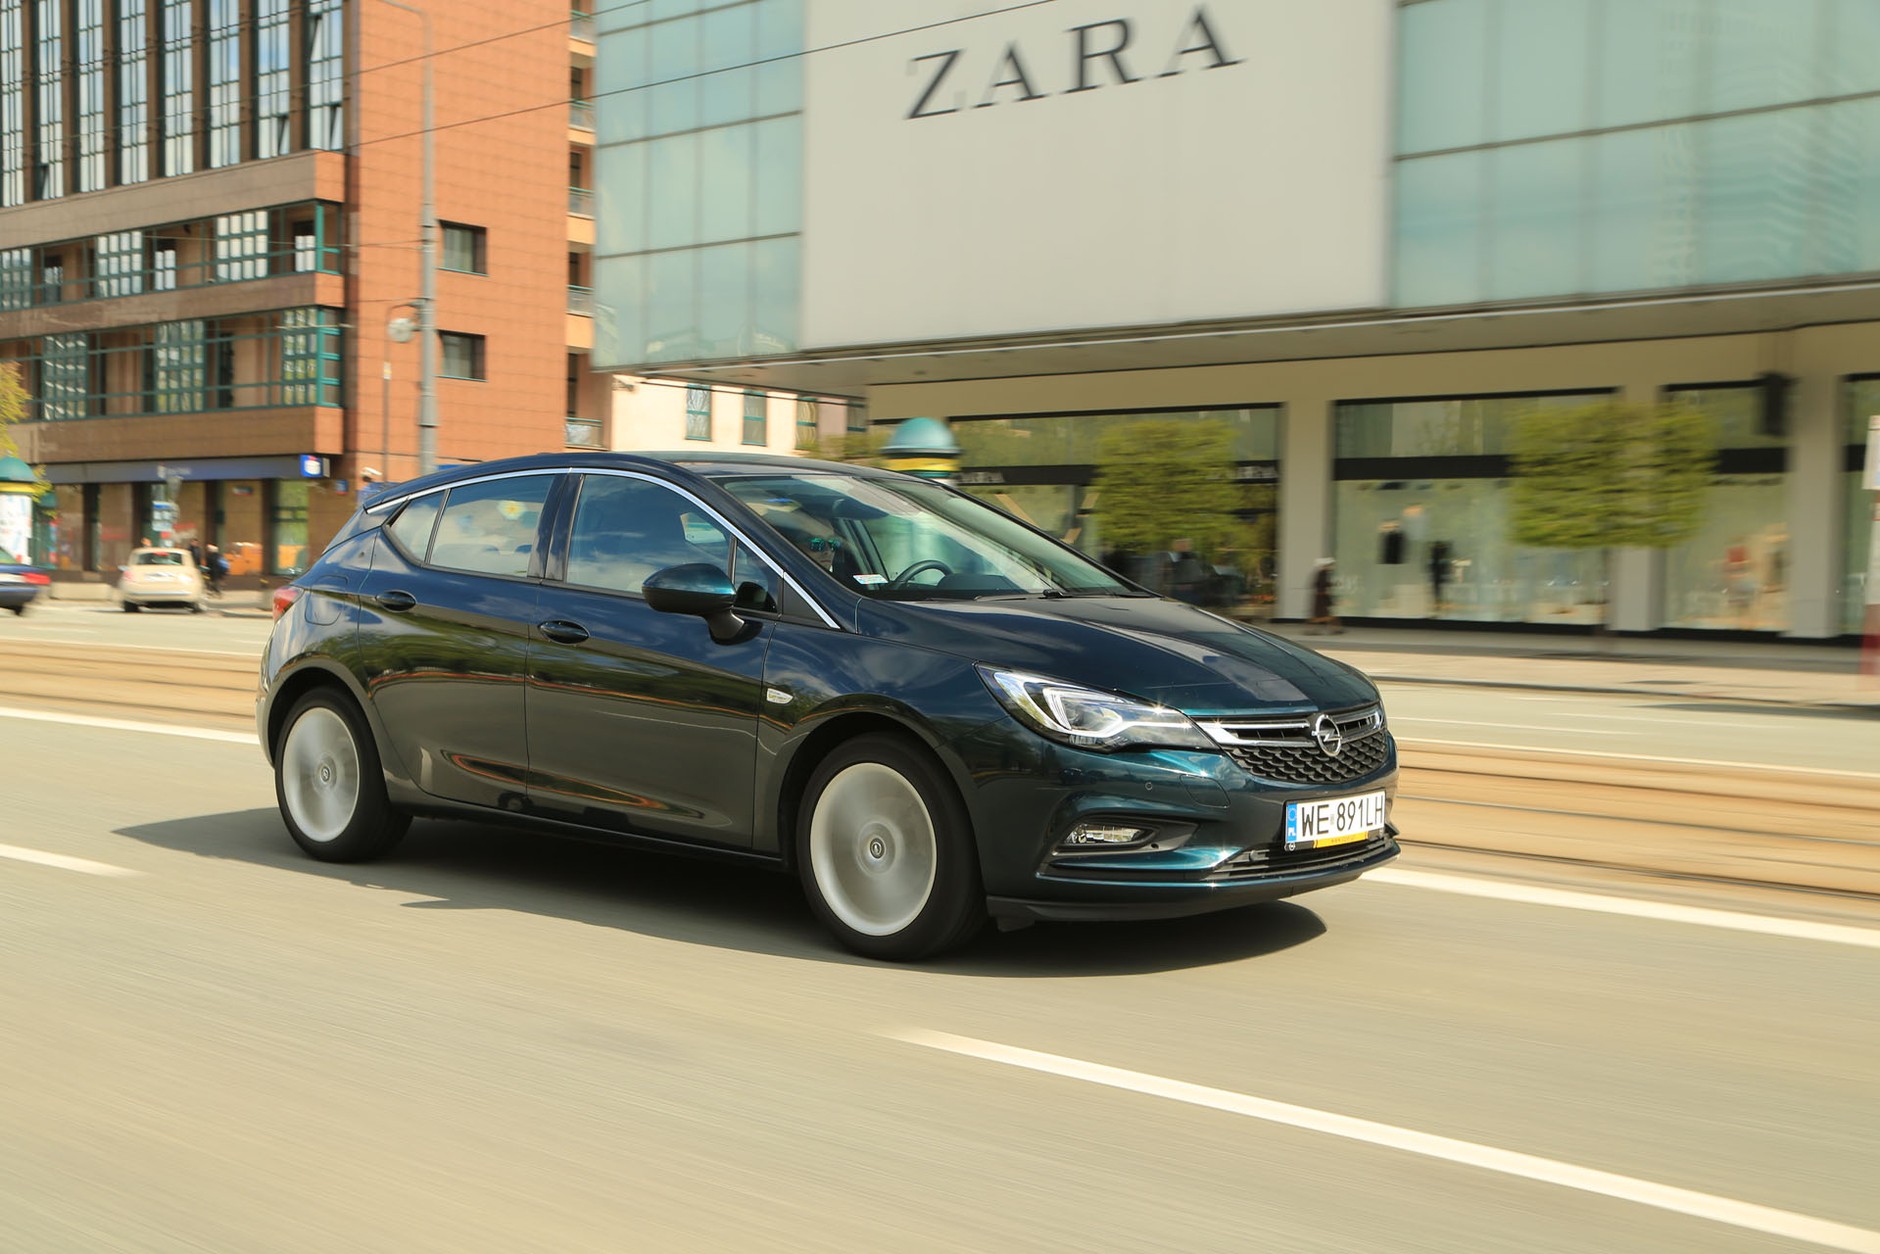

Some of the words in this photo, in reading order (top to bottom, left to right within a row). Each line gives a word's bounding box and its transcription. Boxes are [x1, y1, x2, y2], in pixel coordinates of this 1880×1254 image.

[905, 4, 1246, 119] ZARA
[1301, 804, 1330, 837] WE
[1337, 796, 1383, 831] 891LH
